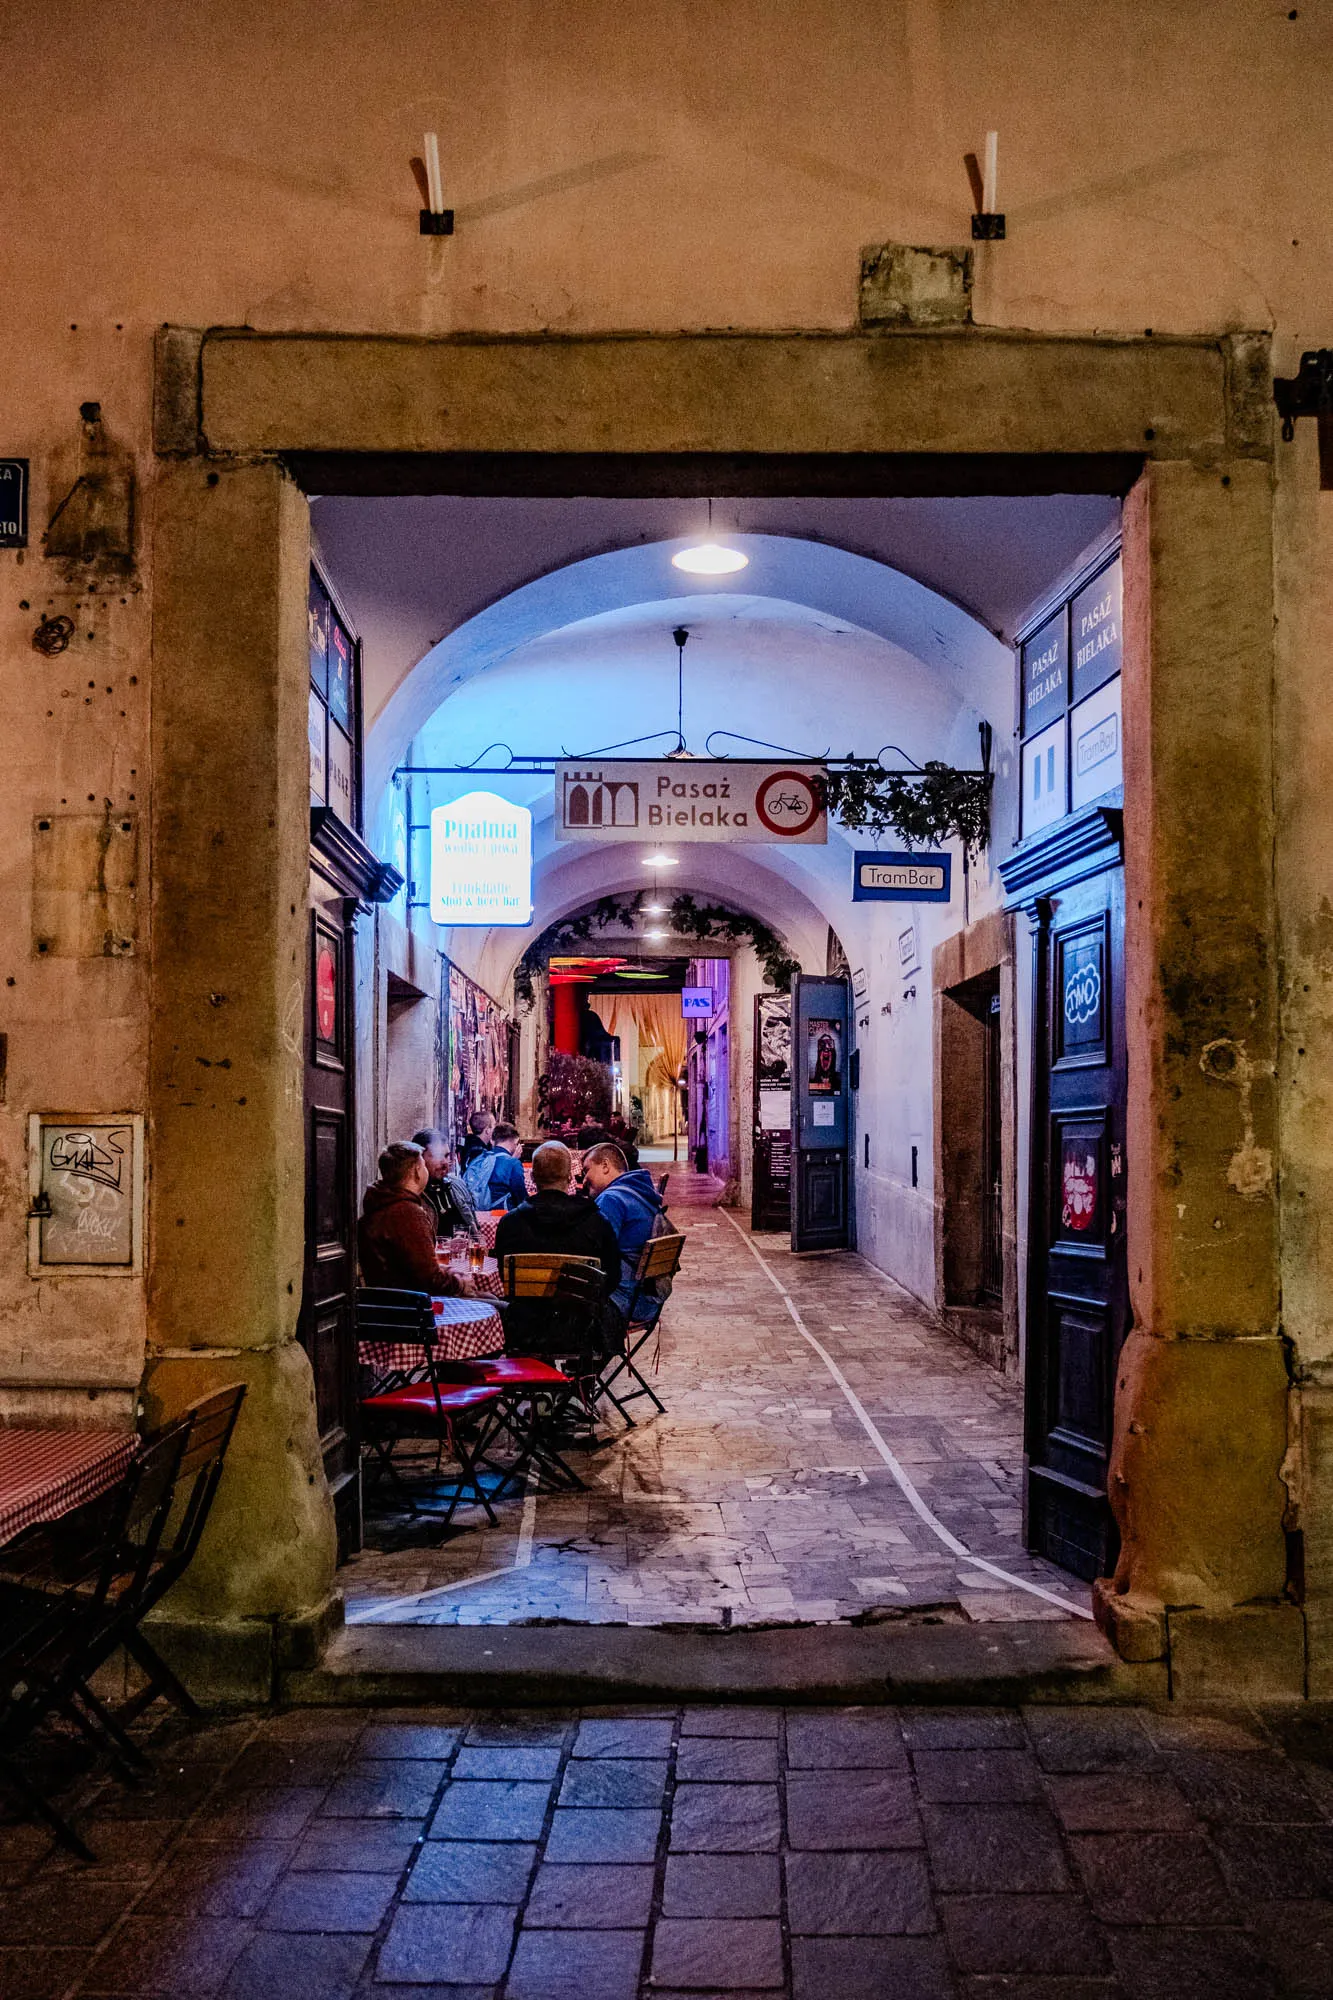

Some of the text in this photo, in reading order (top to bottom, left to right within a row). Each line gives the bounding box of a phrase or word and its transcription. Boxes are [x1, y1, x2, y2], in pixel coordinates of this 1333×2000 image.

[1081, 592, 1112, 637] PASAŻ
[1076, 622, 1118, 670] BIELAKA
[1032, 640, 1059, 680] PASAŻ
[1027, 668, 1063, 710] BIELAKA
[1079, 732, 1115, 761] TramBar
[657, 776, 731, 799] Pasaż
[648, 804, 748, 827] Bielaka
[445, 819, 517, 841] Pijalnia
[868, 868, 936, 886] TramBar
[465, 896, 473, 907] &
[684, 998, 710, 1008] PAS
